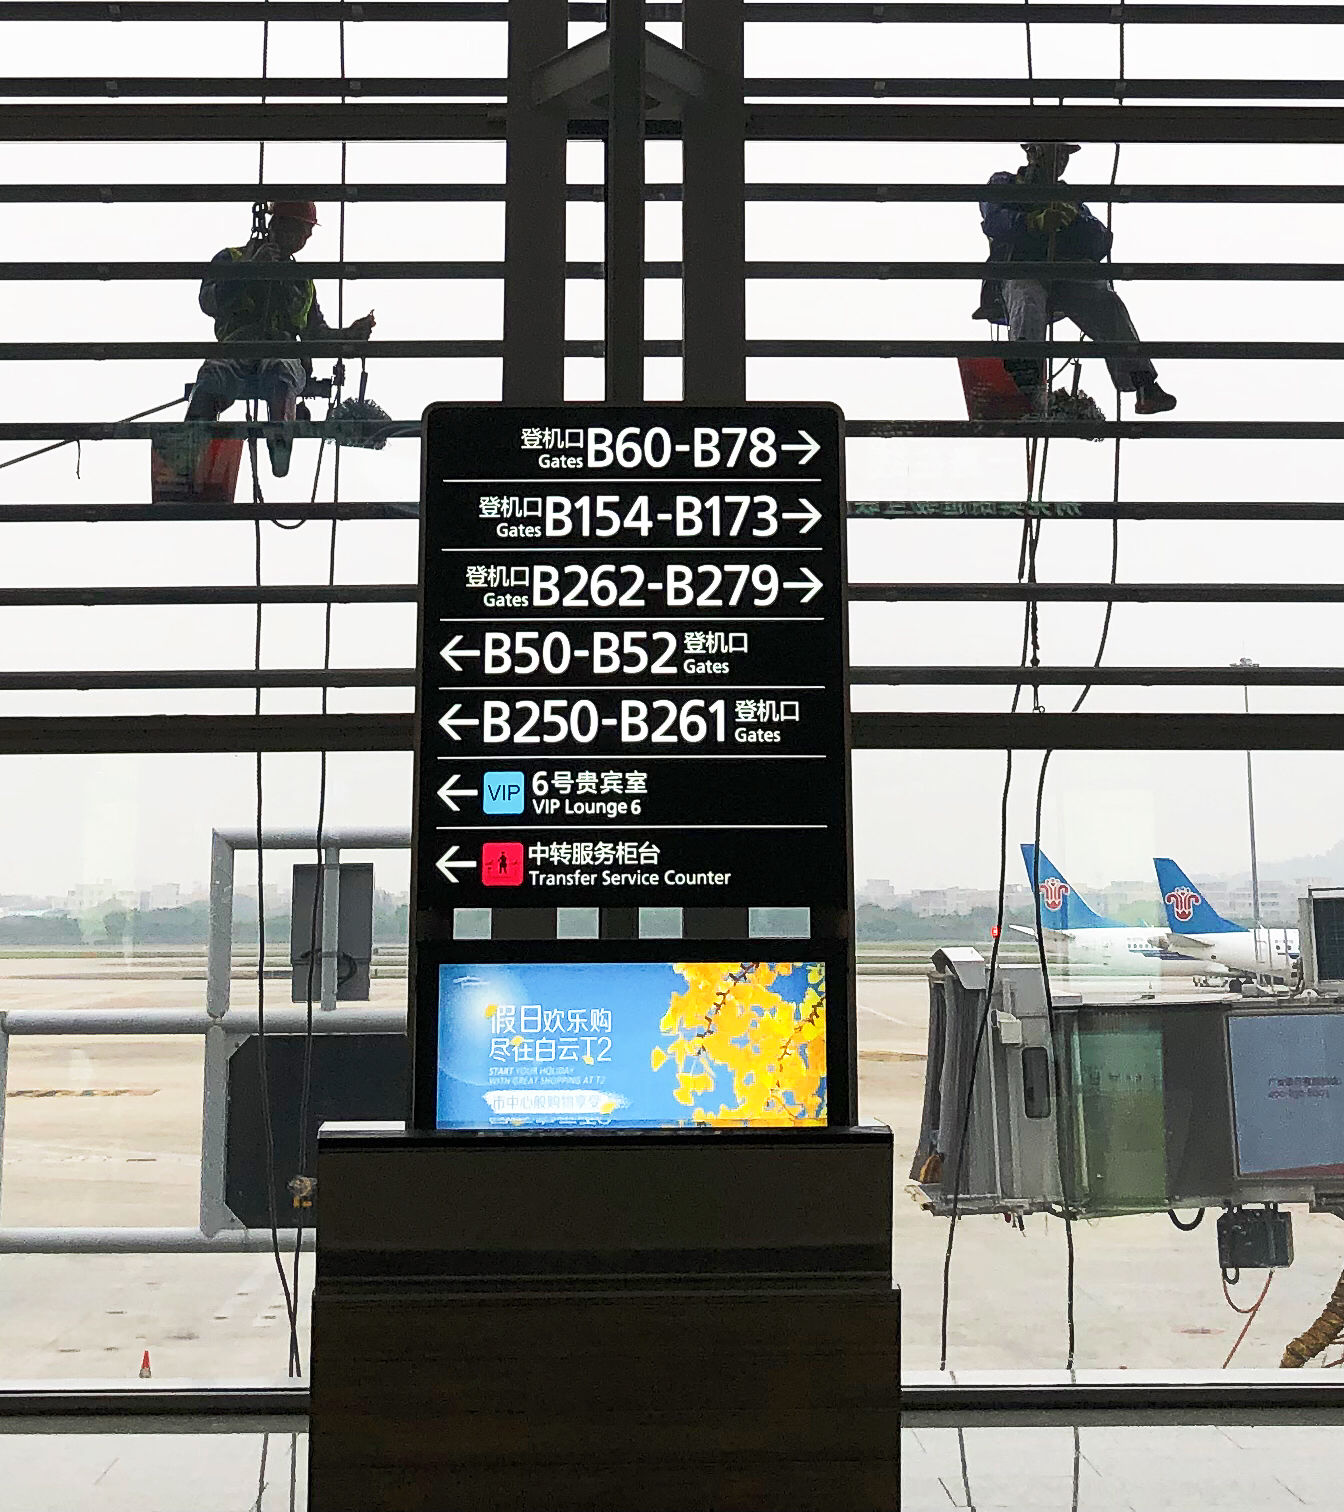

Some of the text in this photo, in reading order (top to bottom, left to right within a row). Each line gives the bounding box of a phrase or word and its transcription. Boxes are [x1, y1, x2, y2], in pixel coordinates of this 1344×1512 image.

[520, 426, 777, 468] 登机口 B60-B78
[538, 453, 584, 469] Gates
[478, 494, 778, 537] 登机口 B154-B173
[496, 522, 542, 538] Gates
[465, 563, 779, 607] 登机口 B262-B279
[483, 592, 529, 608] Gates
[484, 630, 748, 675] B50-B52 登机口
[683, 658, 730, 674] Gates
[482, 698, 800, 744] B250-B261 登机口
[734, 727, 781, 743] Gates
[487, 784, 521, 801] VIP
[531, 770, 648, 797] 6号贵宾室
[531, 798, 642, 819] VIP Lounge 6
[528, 840, 661, 866] 中转服务柜台
[528, 869, 732, 886] Transfer Service Counter
[489, 1004, 613, 1034] 假日欢乐购
[488, 1036, 613, 1063] 尽在白云T2
